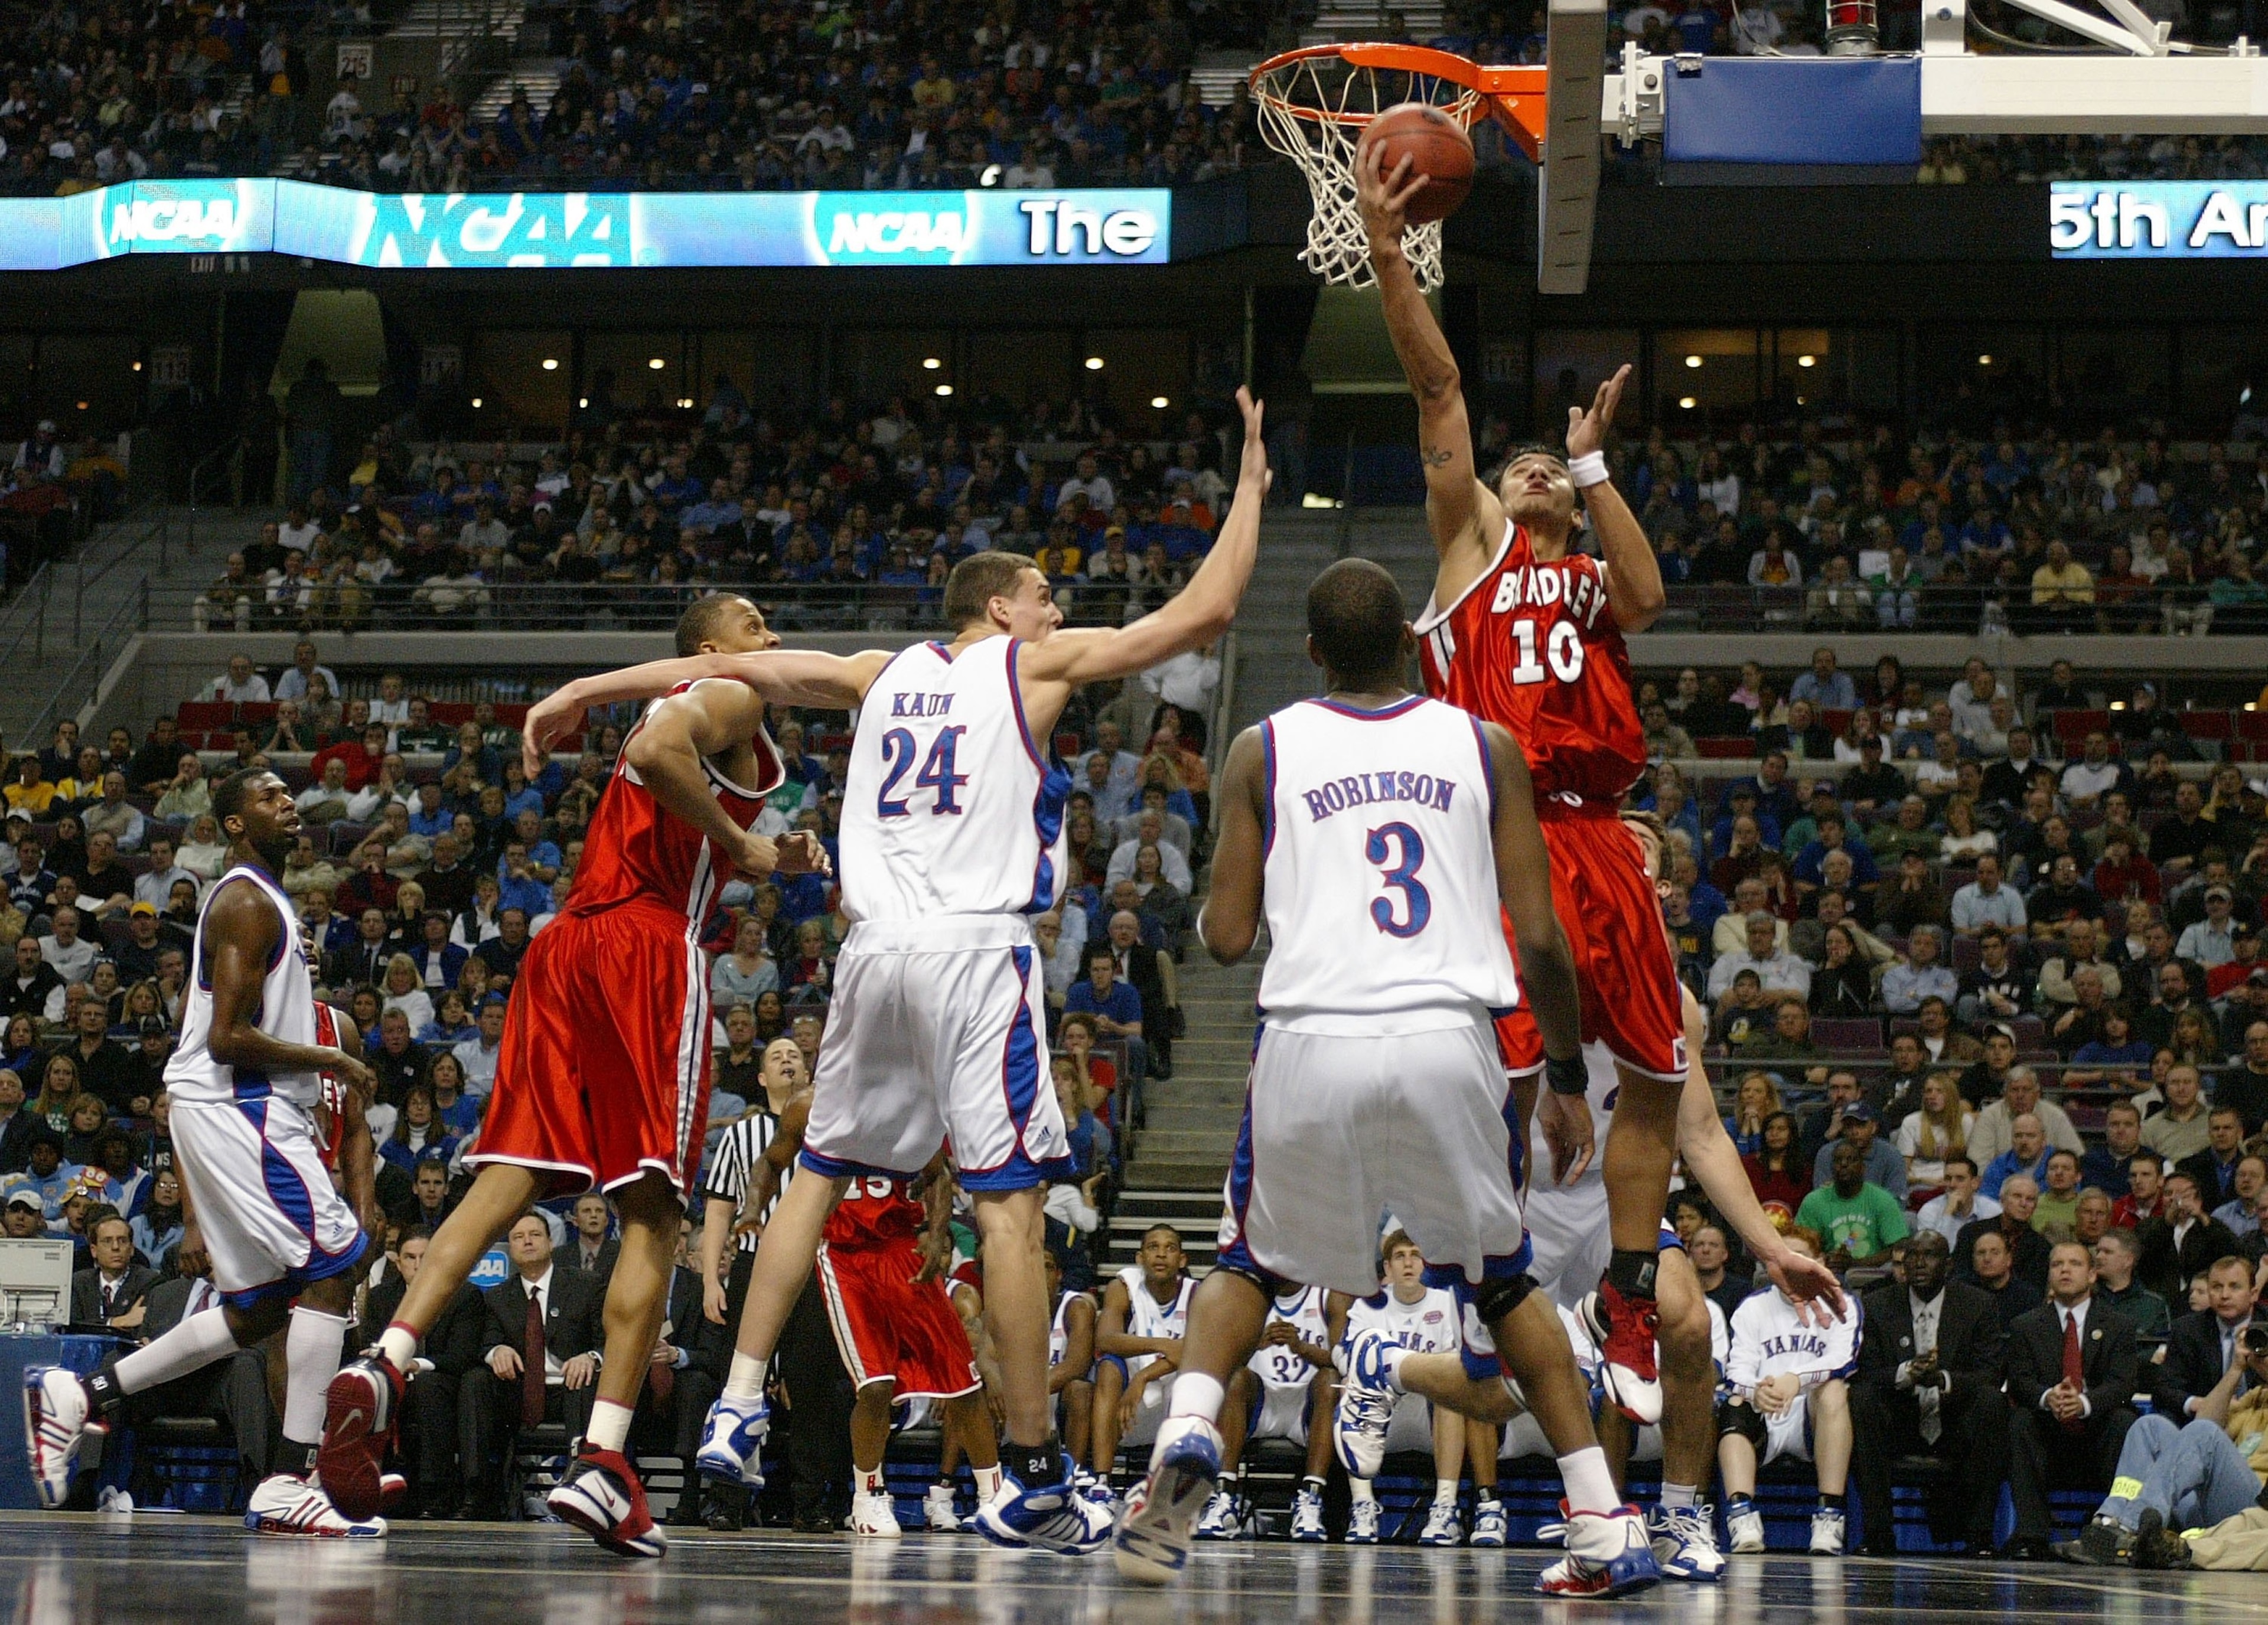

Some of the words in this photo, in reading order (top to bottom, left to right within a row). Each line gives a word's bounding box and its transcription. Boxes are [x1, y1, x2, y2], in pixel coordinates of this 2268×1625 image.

[109, 200, 235, 244] NCAA
[829, 211, 962, 253] NCAA
[1020, 200, 1156, 254] The
[2050, 192, 2166, 248] 5th
[1511, 619, 1583, 684] 10
[878, 725, 970, 818] 24
[1302, 771, 1456, 823] ROBINSON
[1366, 821, 1431, 938] 3
[1273, 1355, 1309, 1382] 32
[1028, 1457, 1048, 1473] 24
